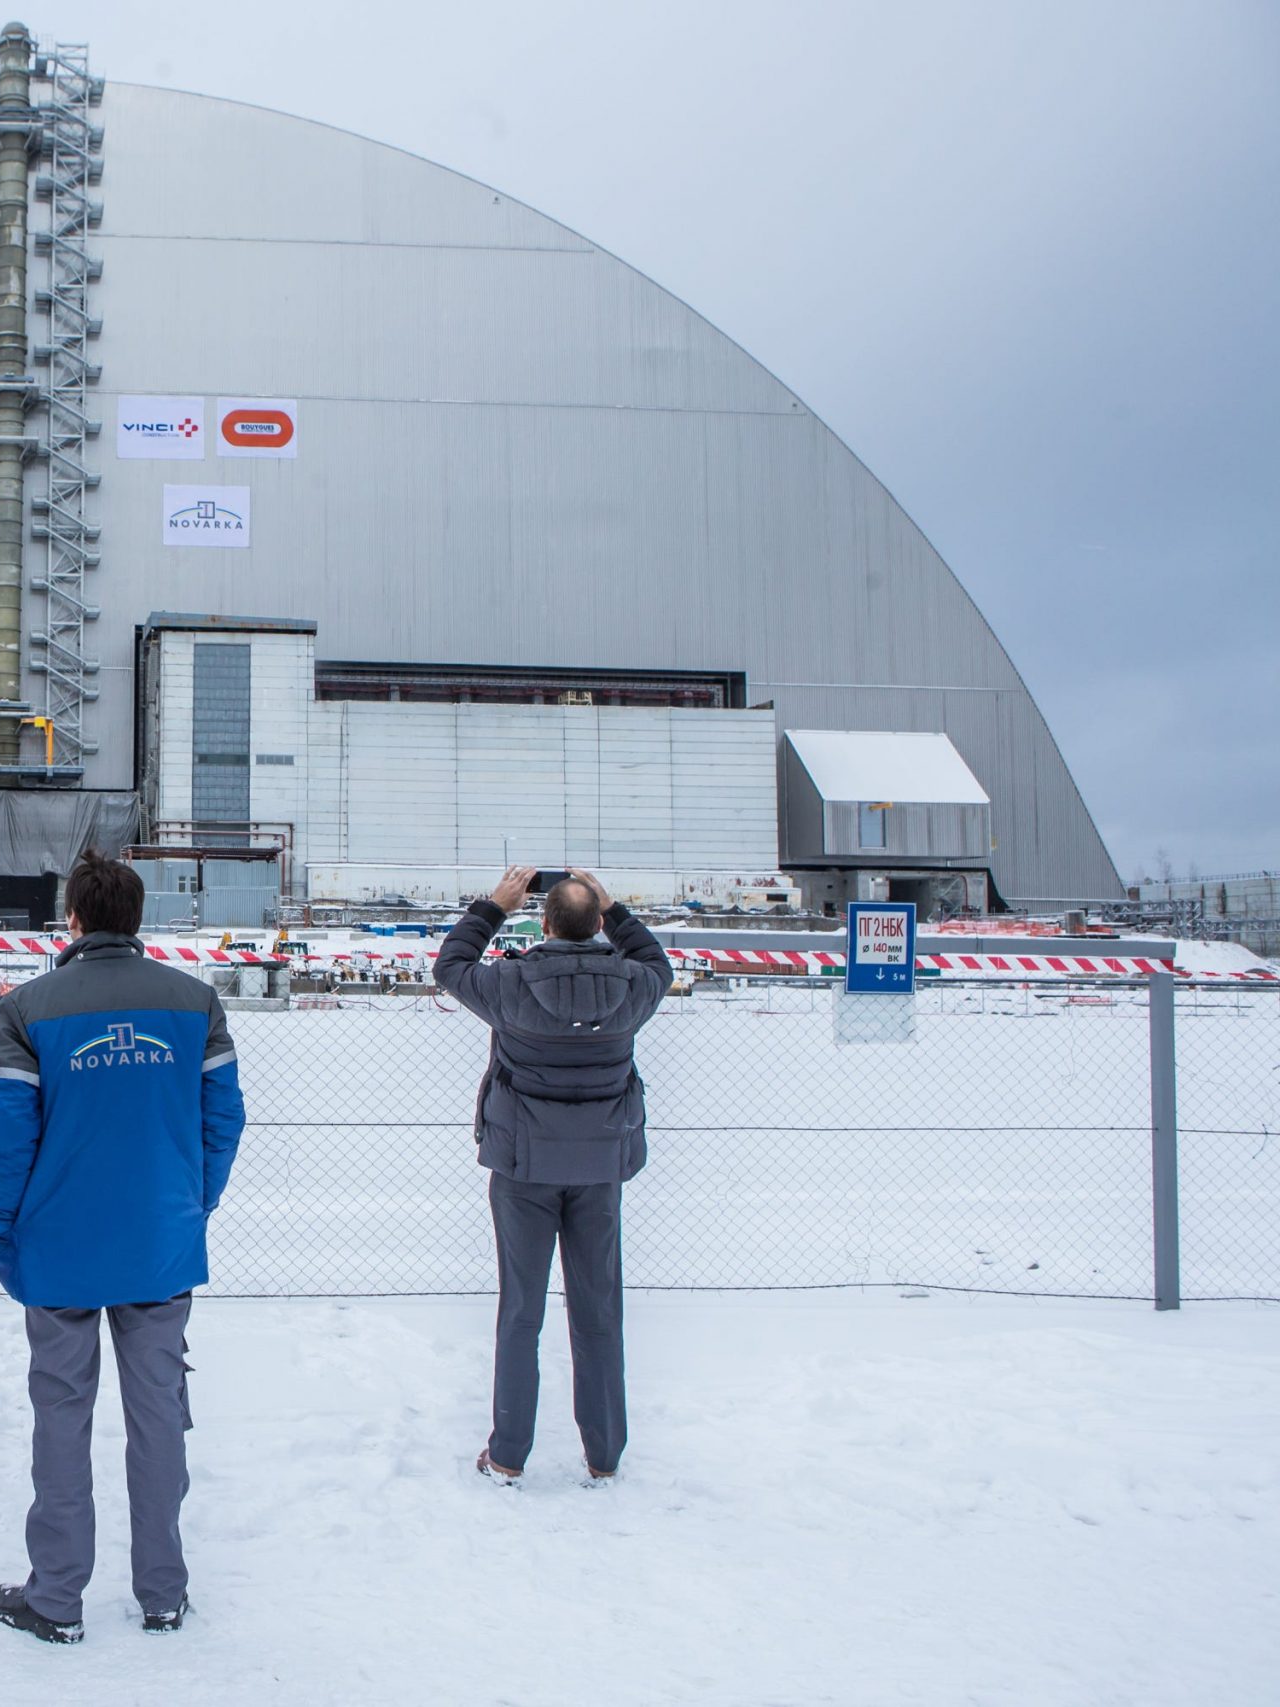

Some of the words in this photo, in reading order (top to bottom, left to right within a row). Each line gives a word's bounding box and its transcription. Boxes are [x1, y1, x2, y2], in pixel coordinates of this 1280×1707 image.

[123, 424, 174, 432] VINCI
[169, 520, 243, 530] NOVARKA
[892, 973, 898, 981] 5
[70, 1051, 175, 1071] NOVARKA
